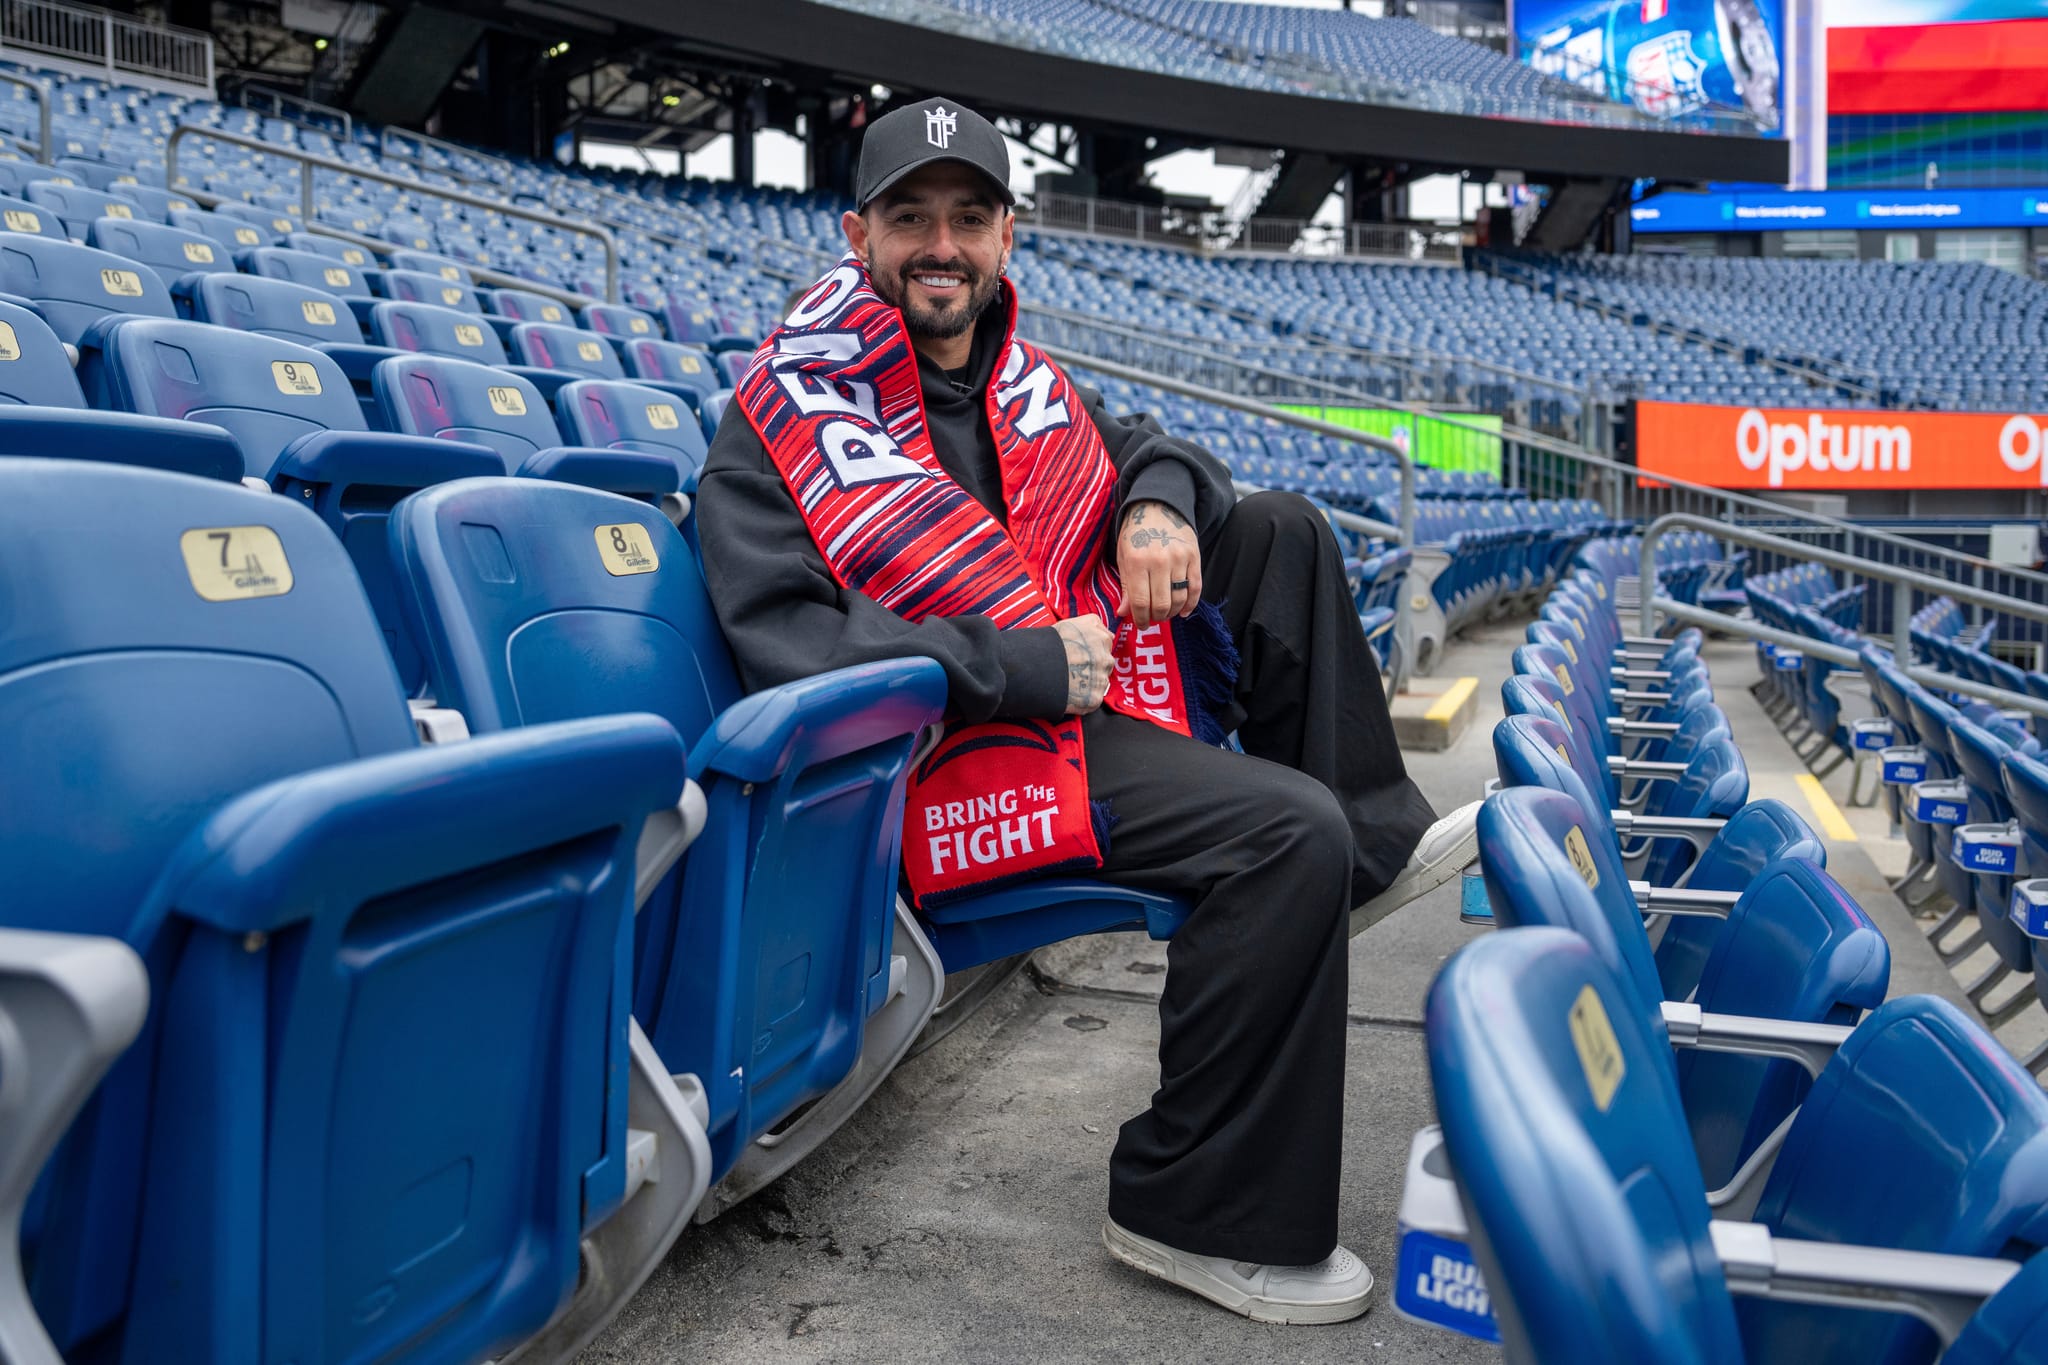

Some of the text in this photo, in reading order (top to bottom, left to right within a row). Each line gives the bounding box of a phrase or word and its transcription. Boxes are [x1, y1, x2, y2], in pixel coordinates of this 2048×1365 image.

[103, 270, 122, 285] 10
[284, 363, 297, 381] 9
[490, 388, 508, 404] 10
[1736, 408, 1912, 487] Optum
[207, 531, 231, 568] 7
[610, 526, 628, 554] 8
[924, 784, 1058, 832] BRING THE
[928, 806, 1060, 876] FIGHT
[1431, 1254, 1487, 1290] BU
[1415, 1272, 1498, 1318] LIGH
